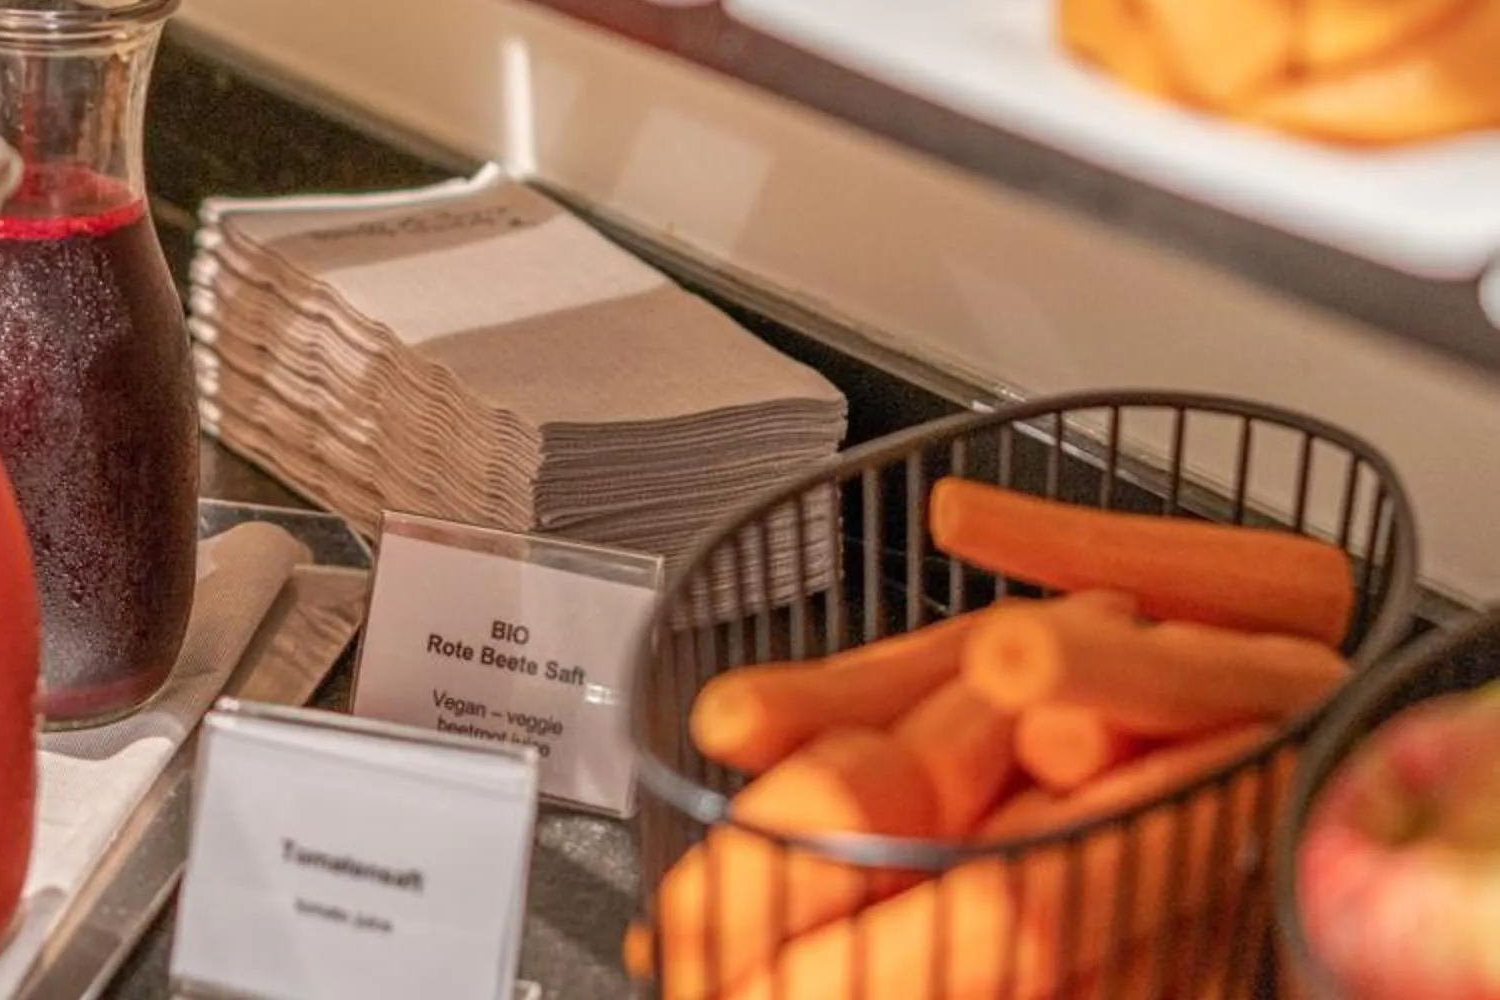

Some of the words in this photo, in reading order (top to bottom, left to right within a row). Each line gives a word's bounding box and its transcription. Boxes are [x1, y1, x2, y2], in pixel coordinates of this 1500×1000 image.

[491, 620, 529, 645] BIO
[426, 633, 473, 661] Rote
[480, 646, 538, 675] Beete
[544, 660, 585, 686] Saft
[432, 689, 486, 718] Vegan
[507, 709, 563, 736] veggie
